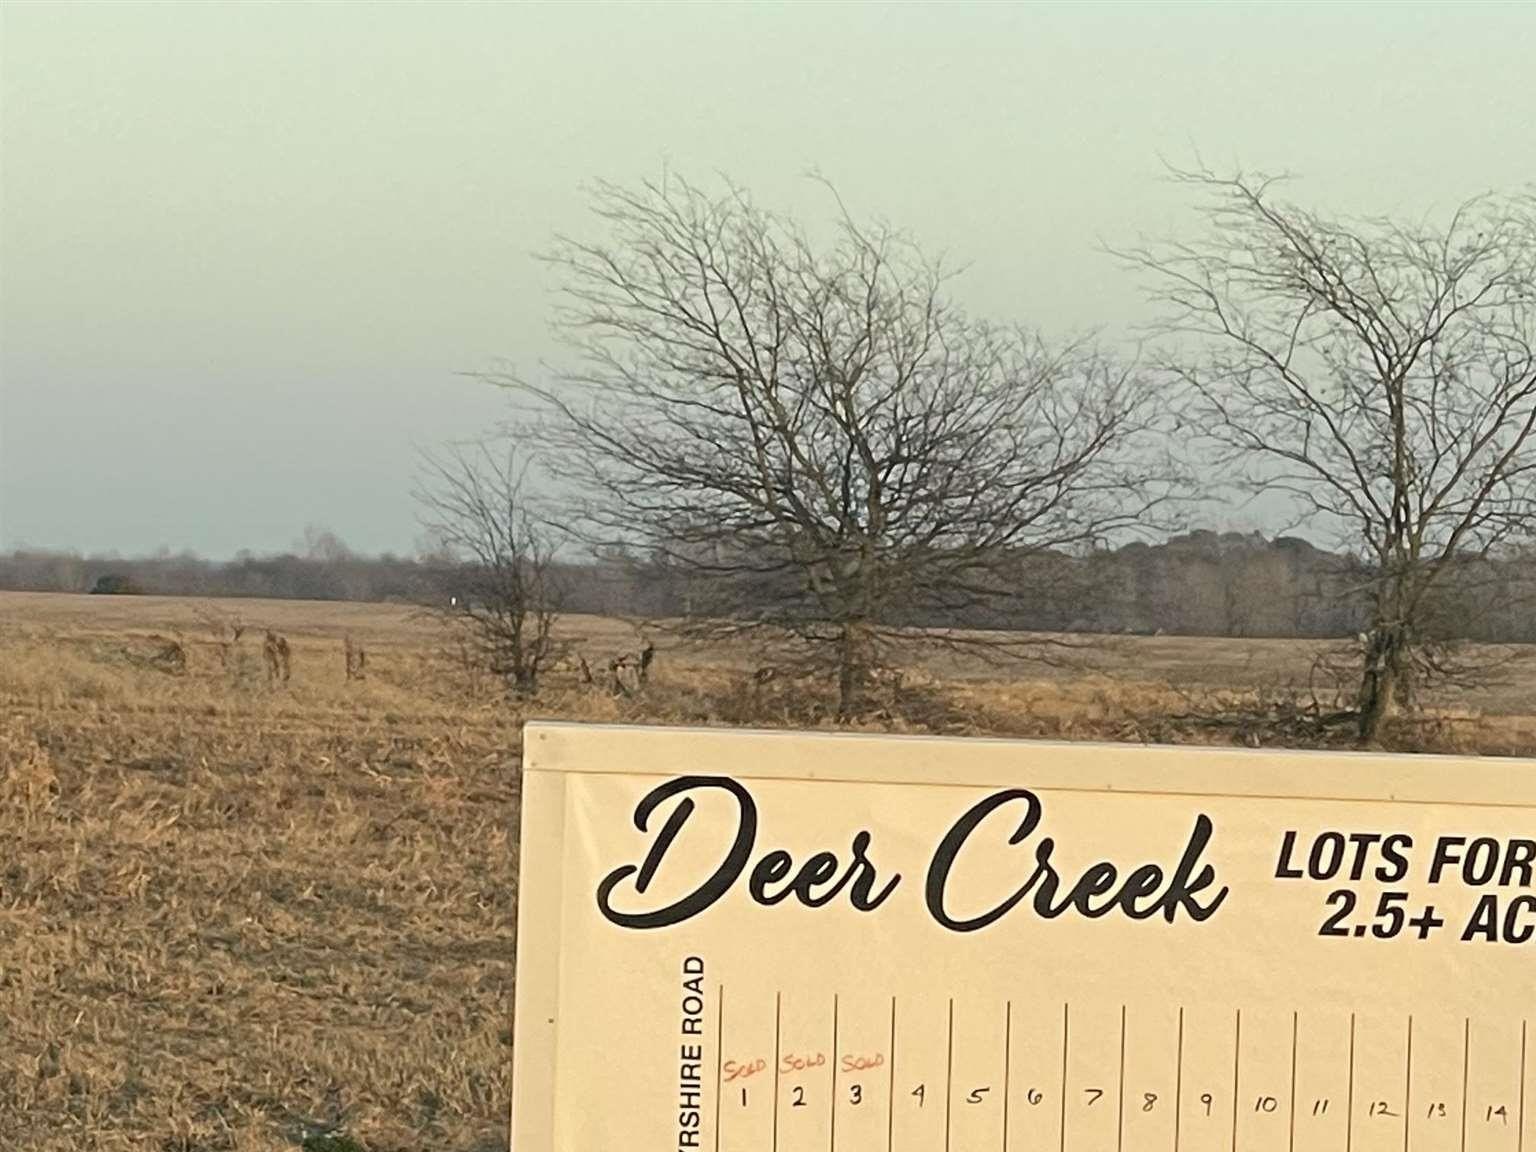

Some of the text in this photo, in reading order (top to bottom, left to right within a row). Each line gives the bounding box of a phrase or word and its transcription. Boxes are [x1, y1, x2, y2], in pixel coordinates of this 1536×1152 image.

[597, 776, 1229, 932] Deer Creek
[1275, 831, 1412, 883] LOTS
[1318, 890, 1443, 939] 2.5+
[682, 957, 705, 1035] ROAD
[780, 1053, 825, 1073] SOLD
[841, 1053, 884, 1072] SOLD
[741, 1087, 747, 1107] 1
[792, 1086, 807, 1107] 2
[849, 1084, 862, 1105] 3
[911, 1083, 925, 1107] 4
[966, 1087, 990, 1104] 5
[1027, 1088, 1043, 1106] 6
[1084, 1088, 1104, 1106] 7
[1142, 1092, 1158, 1112] 8
[1200, 1093, 1213, 1116] 9
[1255, 1096, 1278, 1113] 10
[1312, 1099, 1329, 1116] 11
[1369, 1101, 1398, 1117] 12
[1427, 1102, 1447, 1119] 13
[1486, 1105, 1508, 1126] 14
